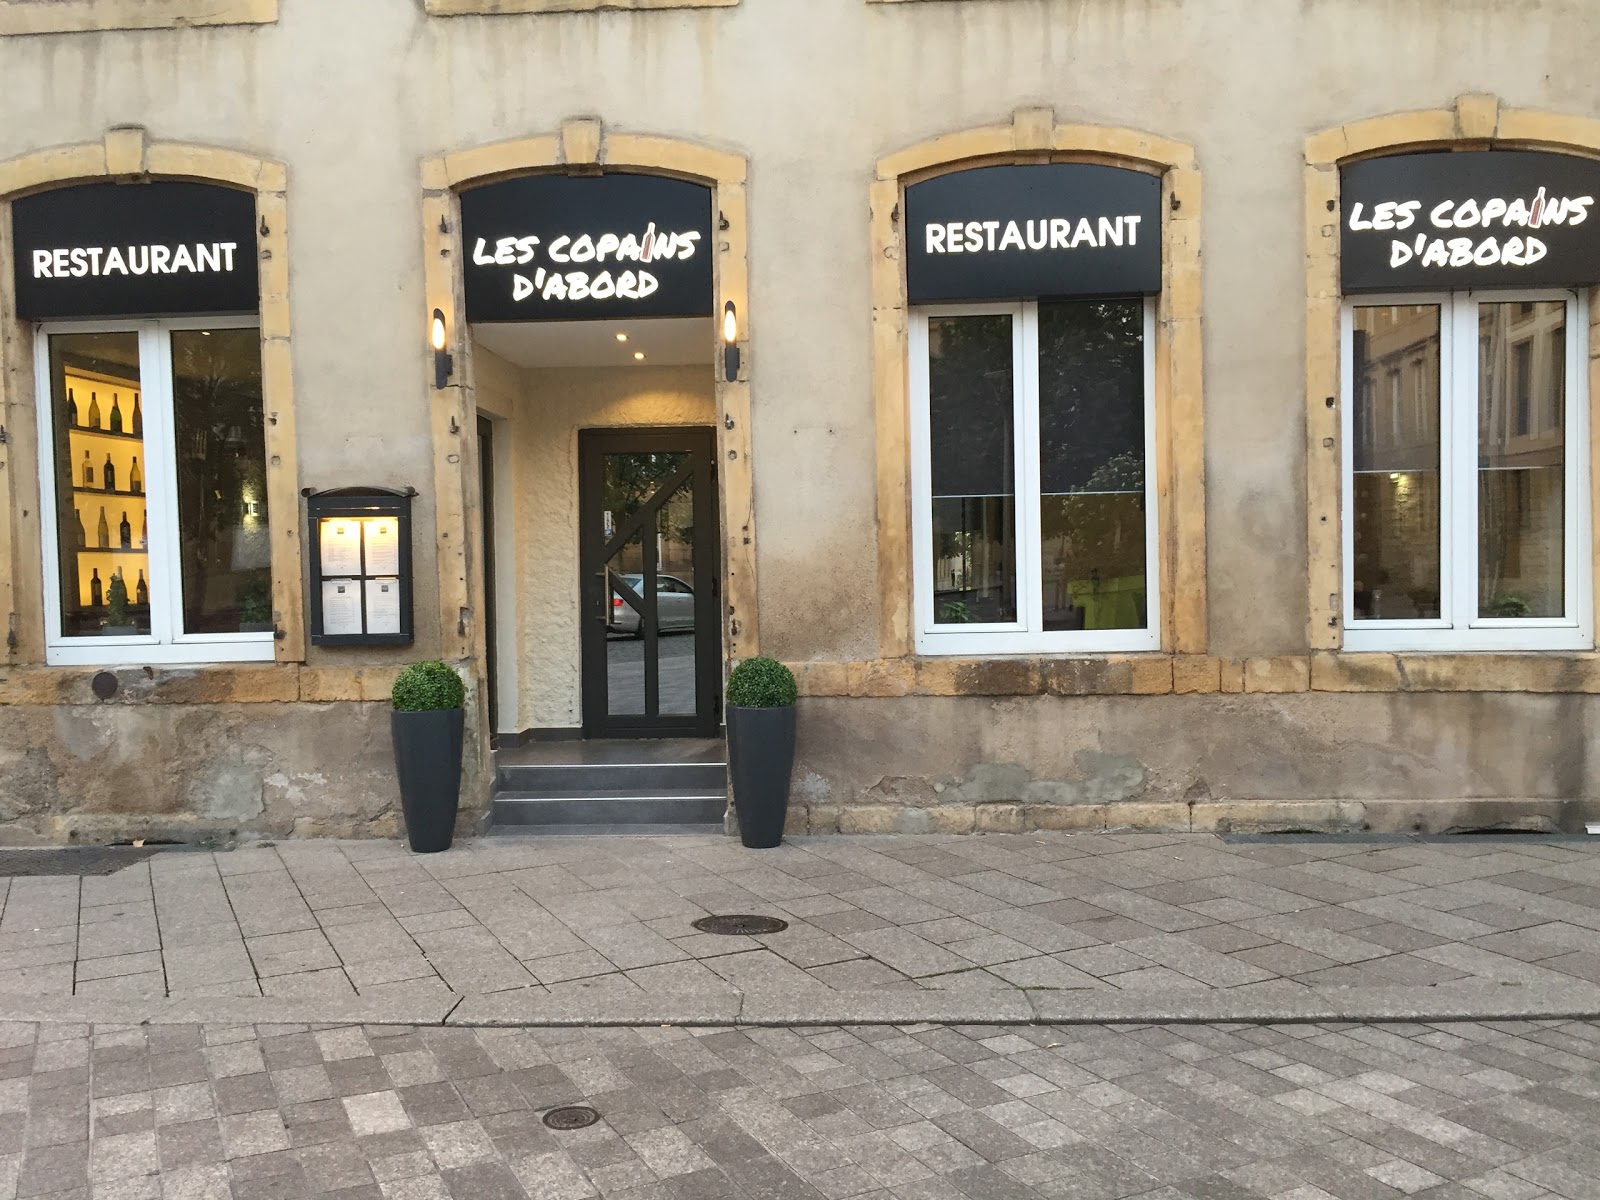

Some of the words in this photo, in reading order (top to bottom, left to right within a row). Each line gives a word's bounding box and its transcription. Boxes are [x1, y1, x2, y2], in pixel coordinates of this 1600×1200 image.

[1348, 200, 1422, 231] LES
[1429, 186, 1595, 230] COPAINS
[472, 235, 541, 266] LES
[548, 221, 702, 264] COPAINS
[925, 215, 1142, 254] RESTAURANT
[1389, 232, 1548, 269] D'ABORD
[32, 242, 237, 279] RESTAURANT
[512, 267, 659, 302] D'ABORD
